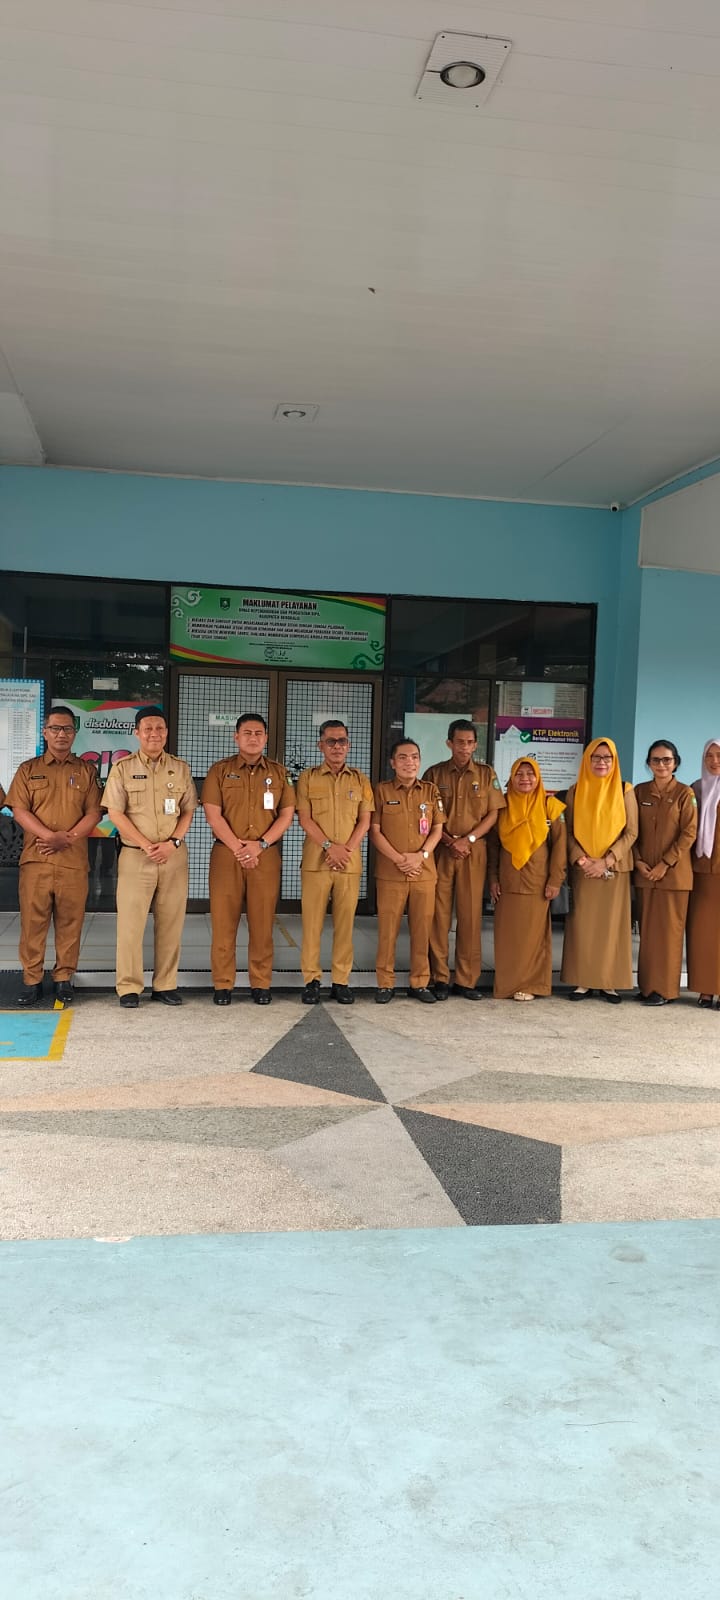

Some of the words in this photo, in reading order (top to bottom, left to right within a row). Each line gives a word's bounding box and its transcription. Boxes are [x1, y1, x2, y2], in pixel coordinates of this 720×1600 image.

[242, 599, 280, 608] MAKLUMAT
[281, 601, 317, 610] PELAYANAN
[548, 729, 579, 737] Elektronik
